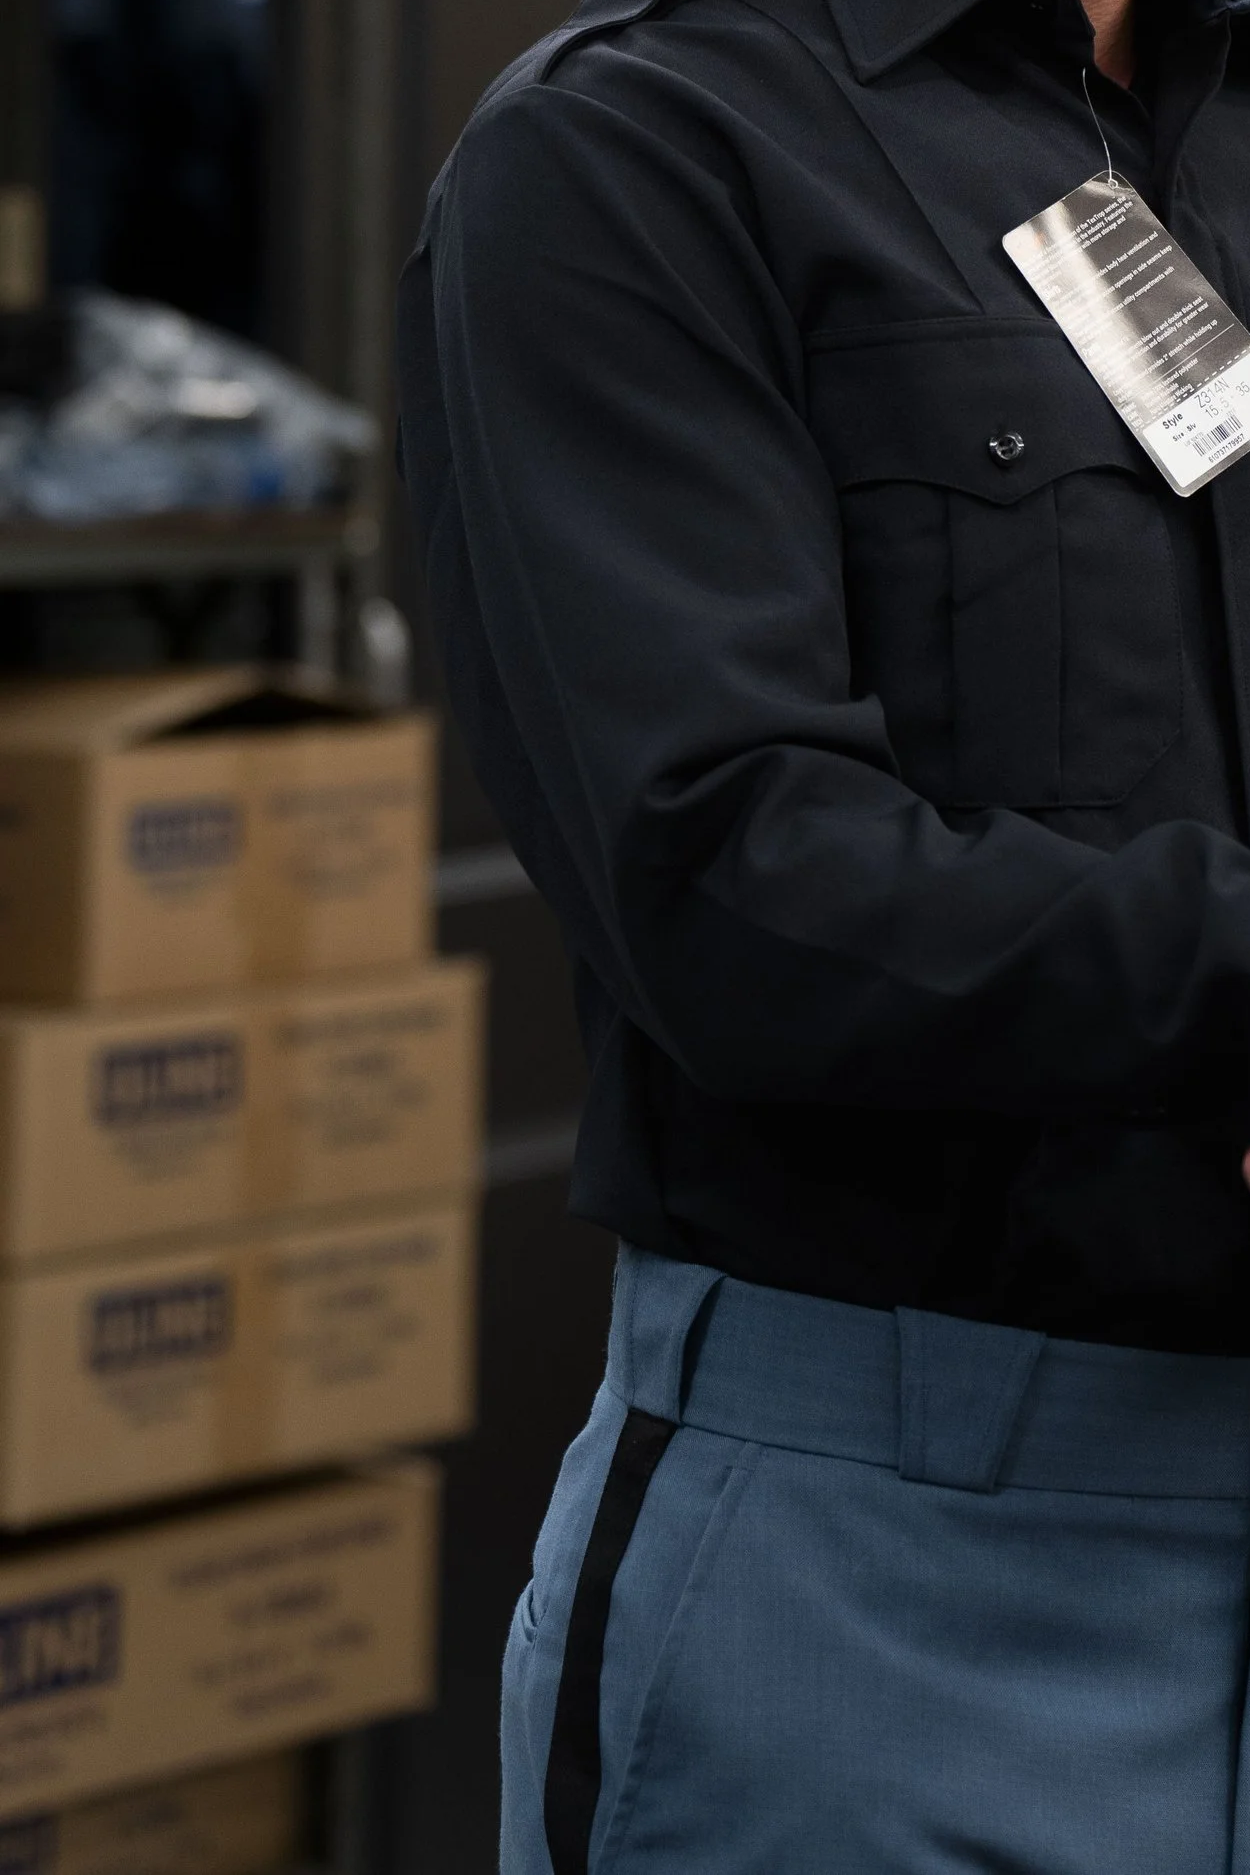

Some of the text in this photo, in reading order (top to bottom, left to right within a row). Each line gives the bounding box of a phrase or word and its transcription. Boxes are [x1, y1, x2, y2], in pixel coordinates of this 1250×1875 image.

[1079, 221, 1089, 230] the
[1116, 194, 1127, 204] the
[1079, 231, 1088, 240] the
[1103, 205, 1127, 224] Featuring
[1123, 199, 1134, 209] the
[1089, 232, 1102, 243] more
[1100, 221, 1118, 236] storage
[1115, 215, 1126, 225] and
[1105, 258, 1120, 271] body
[1116, 252, 1128, 263] heat
[1125, 236, 1150, 256] ventilation
[1147, 230, 1159, 241] and
[1112, 271, 1135, 289] openings
[1131, 267, 1139, 275] in
[1136, 261, 1148, 272] side
[1145, 251, 1162, 265] seams
[1159, 243, 1174, 257] keep
[1121, 292, 1136, 306] utility
[1132, 272, 1166, 298] compartments
[1162, 264, 1175, 276] with
[1141, 332, 1153, 343] blow
[1151, 327, 1160, 335] out
[1158, 320, 1169, 330] and
[1166, 309, 1183, 324] double
[1180, 302, 1194, 314] thick
[1191, 295, 1203, 306] seat
[1147, 338, 1158, 348] and
[1155, 324, 1178, 343] durability
[1175, 319, 1184, 328] for
[1181, 308, 1200, 325] greater
[1196, 301, 1209, 313] wear
[1146, 356, 1165, 372] provides
[1167, 342, 1185, 357] stretch
[1182, 334, 1196, 346] while
[1193, 322, 1212, 338] holding
[1210, 318, 1218, 327] up
[1177, 356, 1200, 375] polyester
[1160, 376, 1231, 432] Style Z314N
[1171, 429, 1185, 442] Size
[1185, 421, 1197, 432] Slv
[1233, 379, 1250, 397] 35
